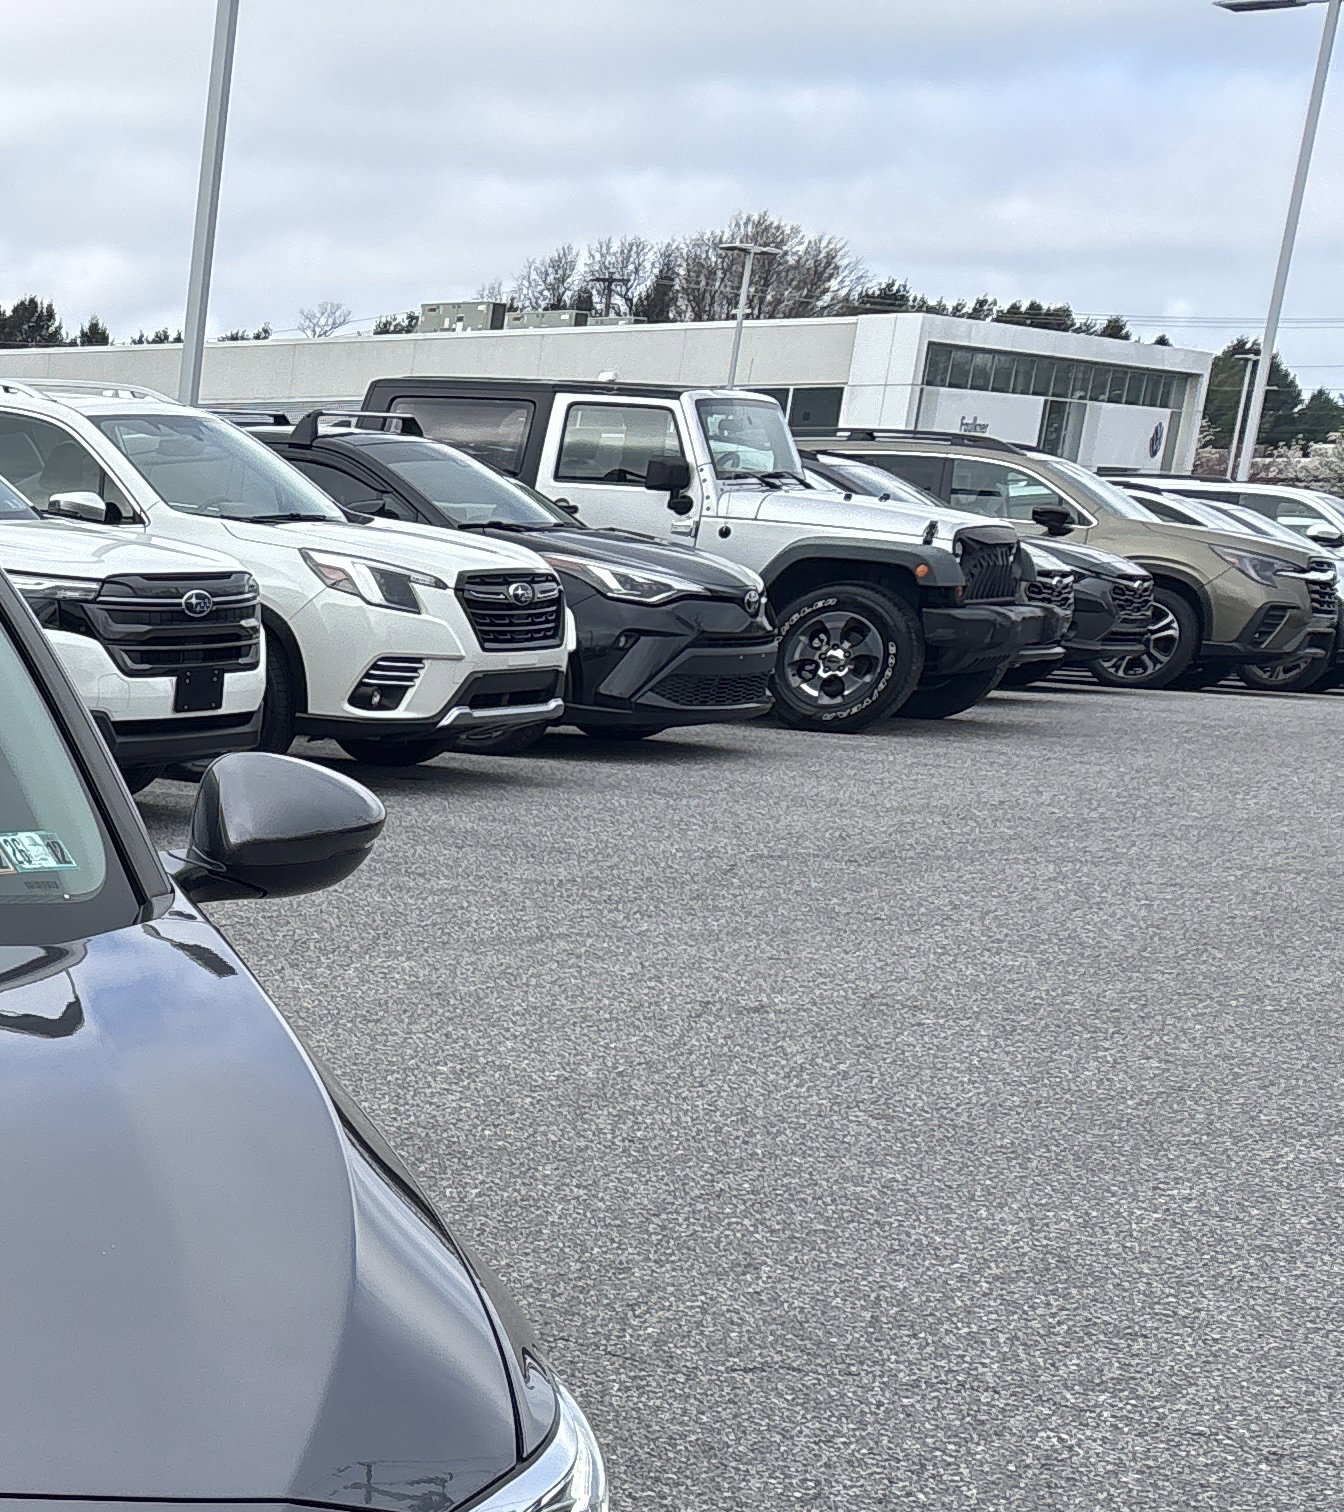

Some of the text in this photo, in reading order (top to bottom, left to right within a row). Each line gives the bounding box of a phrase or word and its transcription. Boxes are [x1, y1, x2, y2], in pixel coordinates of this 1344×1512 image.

[822, 641, 897, 720] GOODYEAR
[3, 838, 74, 864] 26 12
